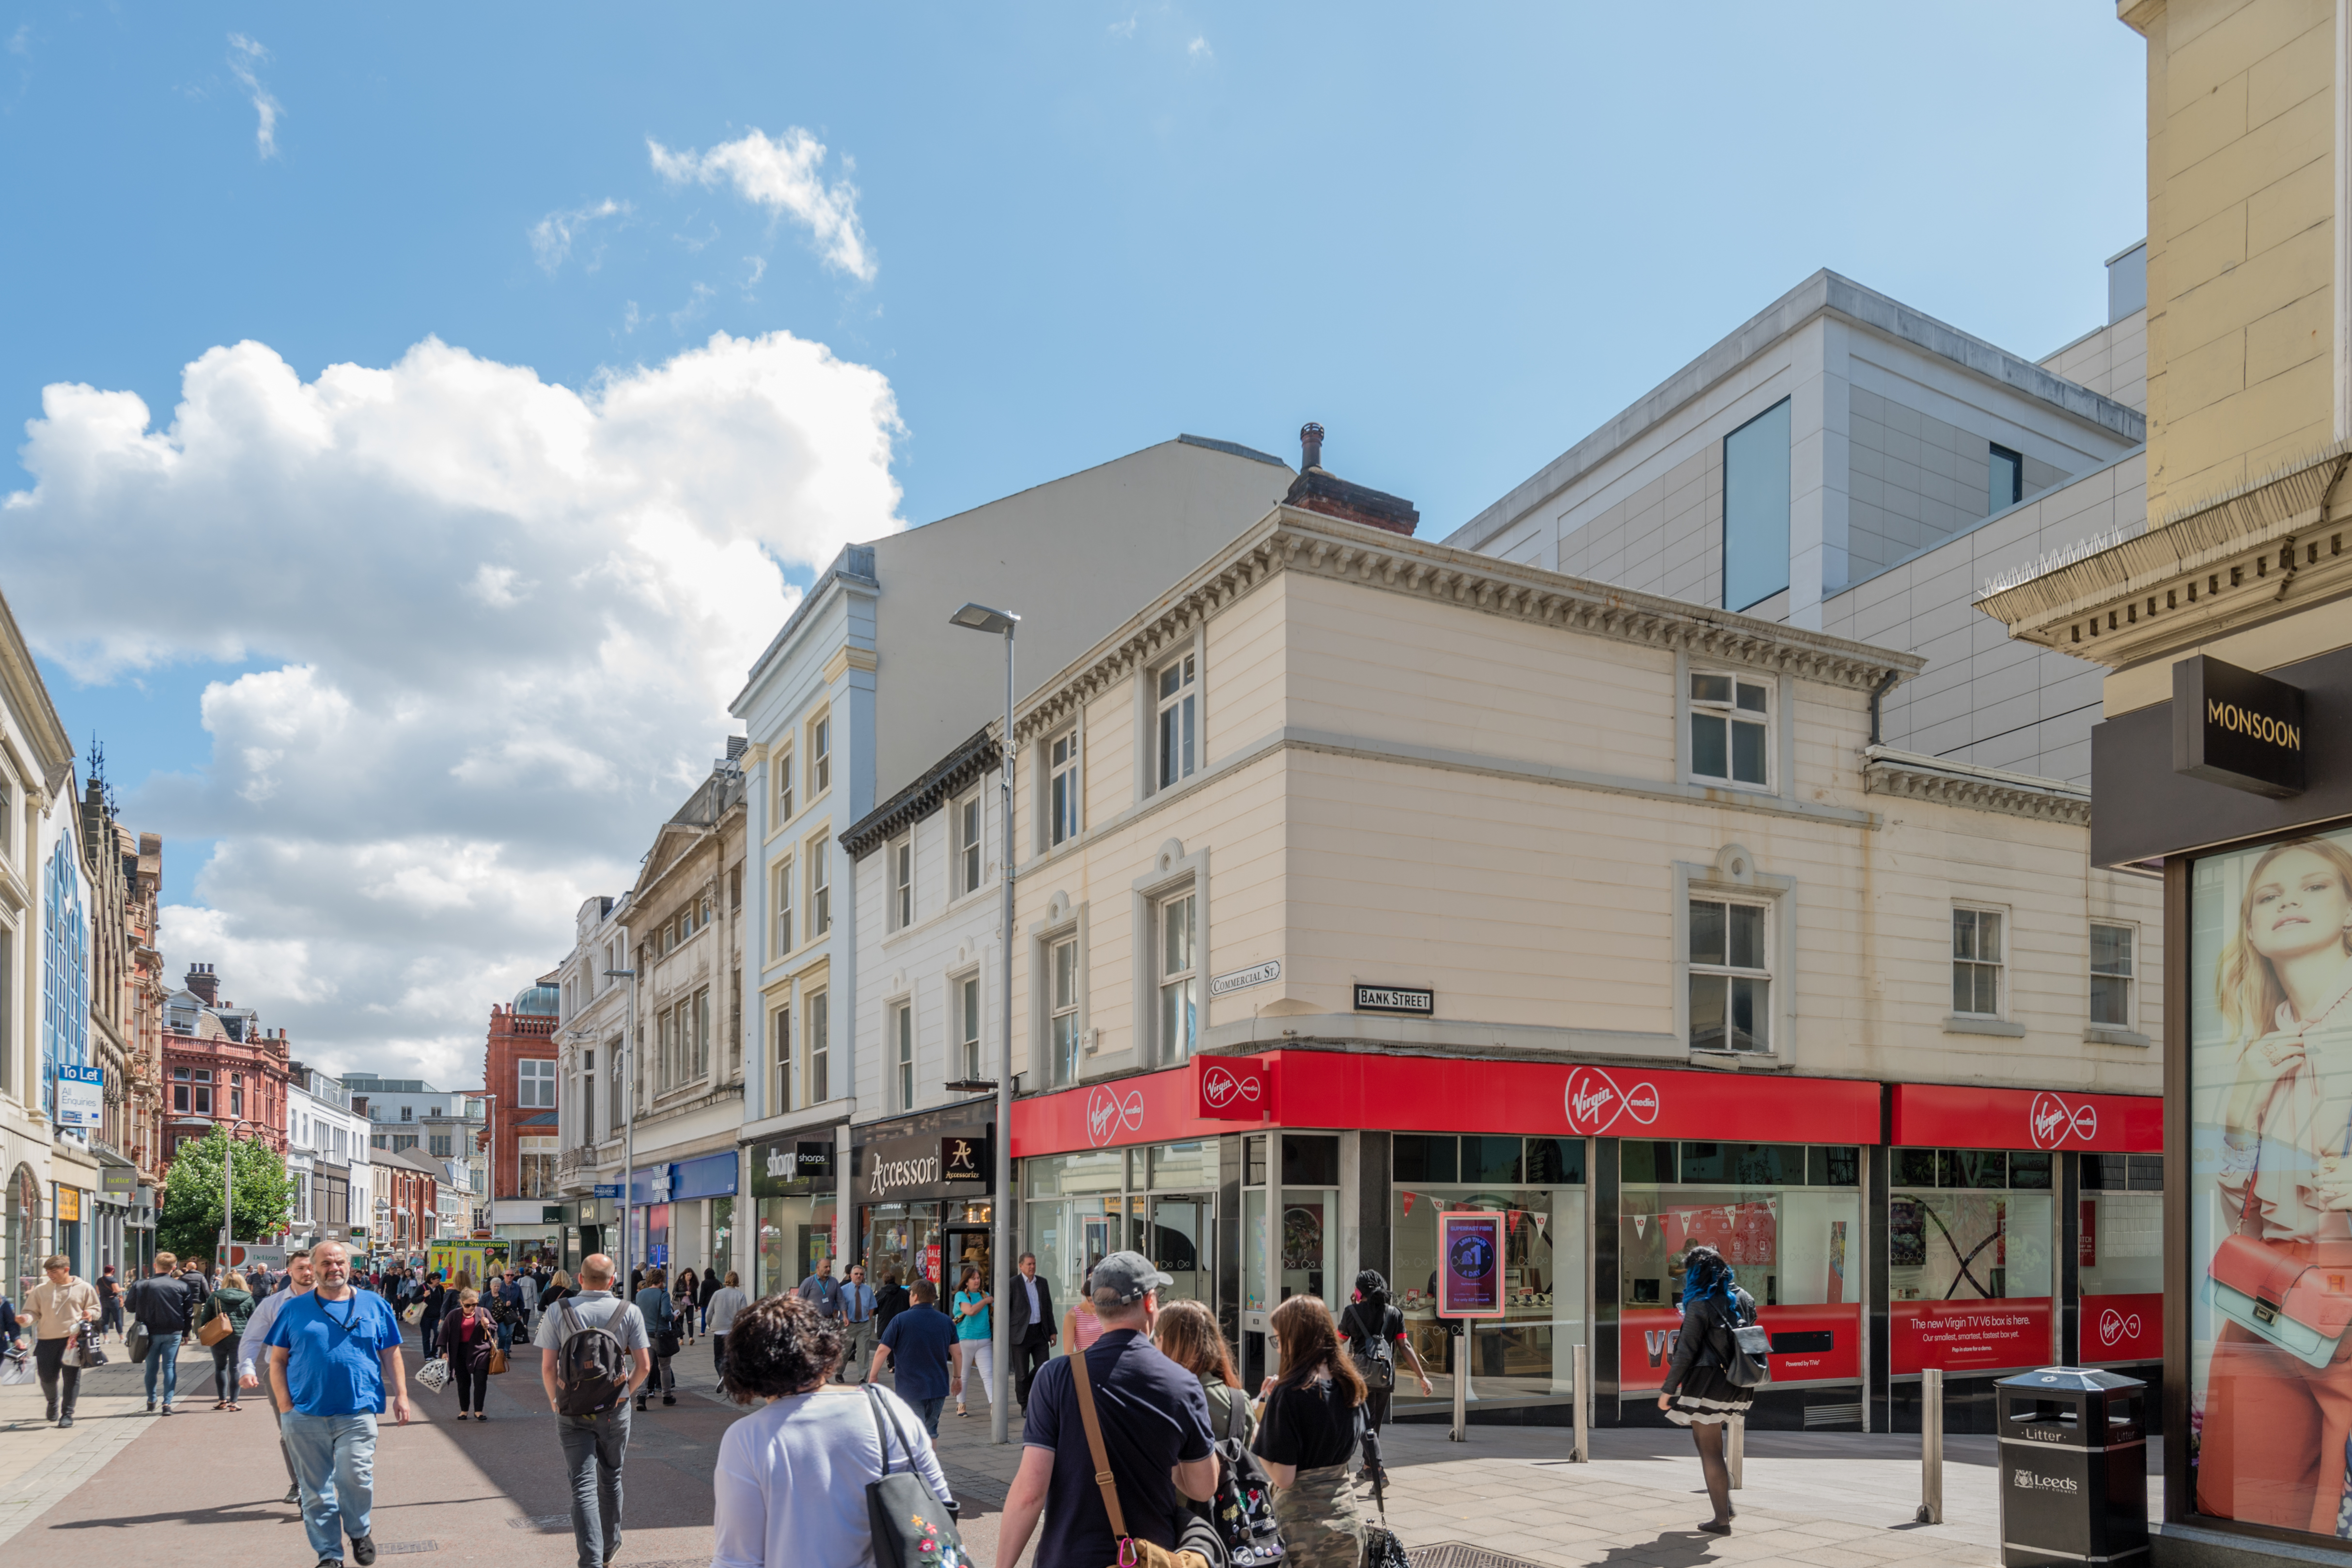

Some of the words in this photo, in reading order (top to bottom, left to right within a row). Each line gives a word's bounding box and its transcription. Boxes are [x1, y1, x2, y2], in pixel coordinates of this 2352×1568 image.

[2208, 698, 2300, 751] MONSOON
[1214, 972, 1262, 992] COMMERCIAL
[1264, 966, 1276, 978] ST.
[1361, 990, 1389, 1005] BANK
[1392, 992, 1428, 1007] STREET
[62, 1065, 77, 1079] To
[80, 1067, 98, 1081] Let
[1207, 1073, 1232, 1101] Virgin
[62, 1095, 96, 1107] Enquiries
[1572, 1077, 1614, 1124] Virgin
[1631, 1098, 1655, 1107] media
[1091, 1095, 1115, 1136] Virgin
[1125, 1105, 1141, 1115] media
[2035, 1101, 2065, 1140] Virgin
[798, 1153, 825, 1164] sharps
[950, 1139, 975, 1169] A
[767, 1148, 796, 1182] sharp
[870, 1144, 939, 1196] Accessori
[946, 1171, 980, 1179] Accessorize
[652, 1176, 670, 1191] HALIFAX
[1459, 1237, 1472, 1247] LESS
[1472, 1237, 1487, 1248] THAN
[928, 1249, 940, 1258] SALE
[1461, 1245, 1481, 1265] £1
[1468, 1269, 1480, 1277] DAY
[1911, 1318, 1926, 1329] The
[1945, 1317, 1966, 1330] Virgin
[1967, 1316, 1978, 1327] TV
[1979, 1316, 1990, 1326] V6
[1992, 1315, 2005, 1326] box
[2006, 1315, 2011, 1325] is
[2013, 1315, 2030, 1325] here.
[2103, 1316, 2120, 1338] Virgin
[1923, 1334, 1933, 1342] Our
[1934, 1333, 1957, 1341] smallest,
[1958, 1332, 1982, 1340] smartest,
[2010, 1331, 2019, 1339] yet.
[2026, 1428, 2061, 1442] Litter
[2117, 1430, 2135, 1442] Litter
[2035, 1475, 2077, 1490] Leeds
